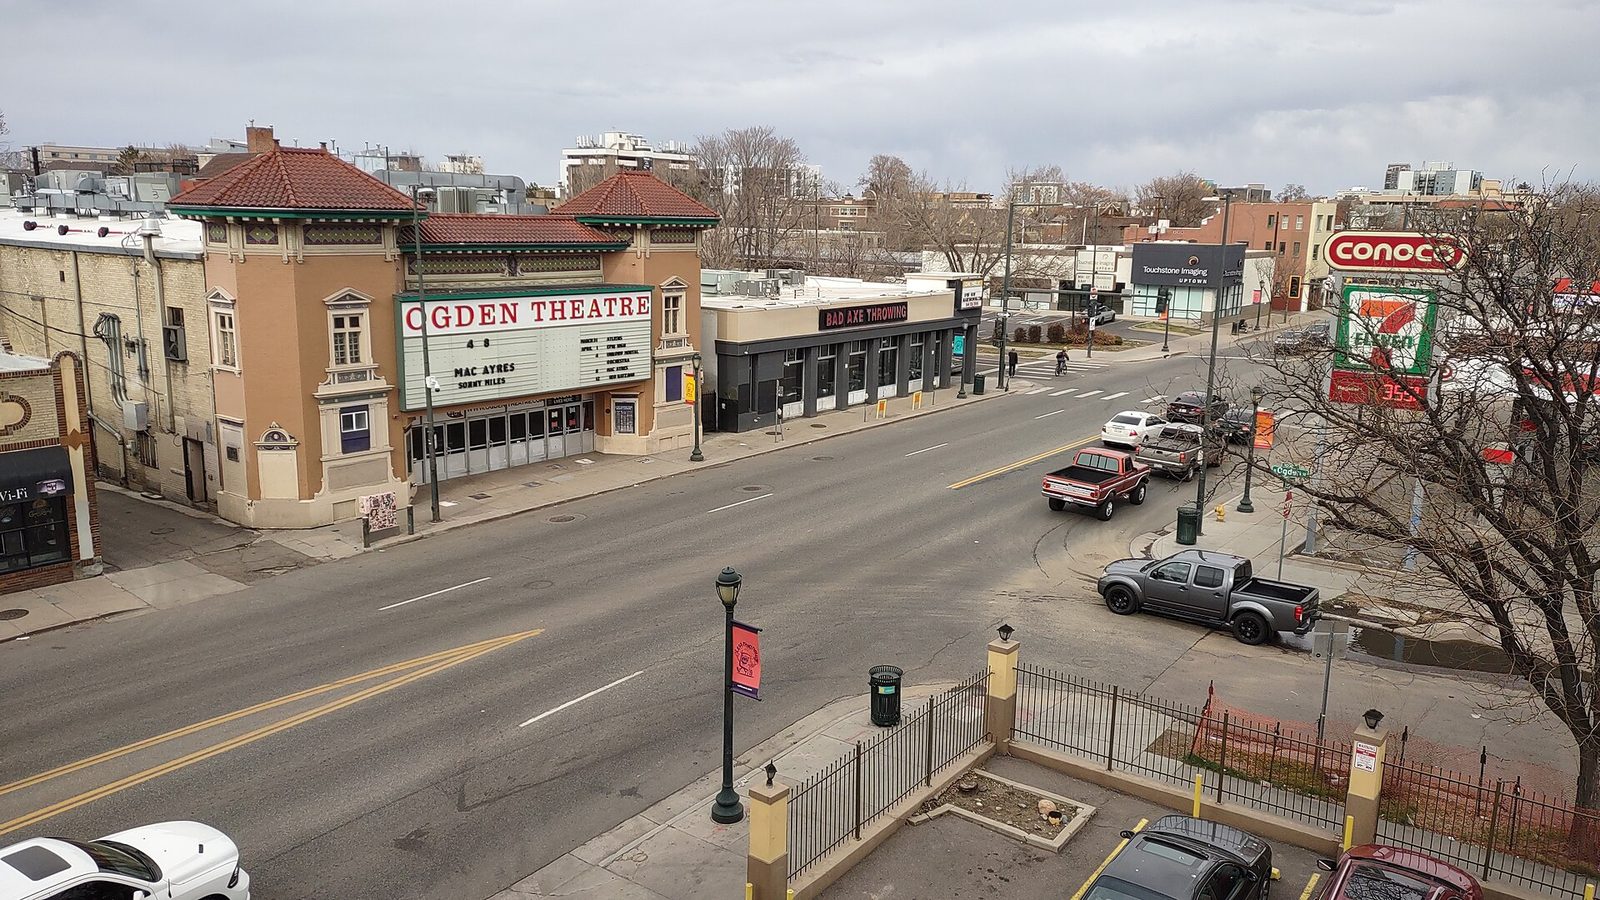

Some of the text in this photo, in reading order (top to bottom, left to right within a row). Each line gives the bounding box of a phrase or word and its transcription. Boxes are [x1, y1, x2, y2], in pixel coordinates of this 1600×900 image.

[1143, 265, 1208, 277] Touchstone Imaging
[405, 296, 650, 330] OGDEN THEATRE
[826, 304, 907, 327] BAD AXE THROWING
[466, 338, 490, 349] 4 8
[454, 362, 515, 378] MAC AYRES
[458, 377, 506, 389] SONNY MILES
